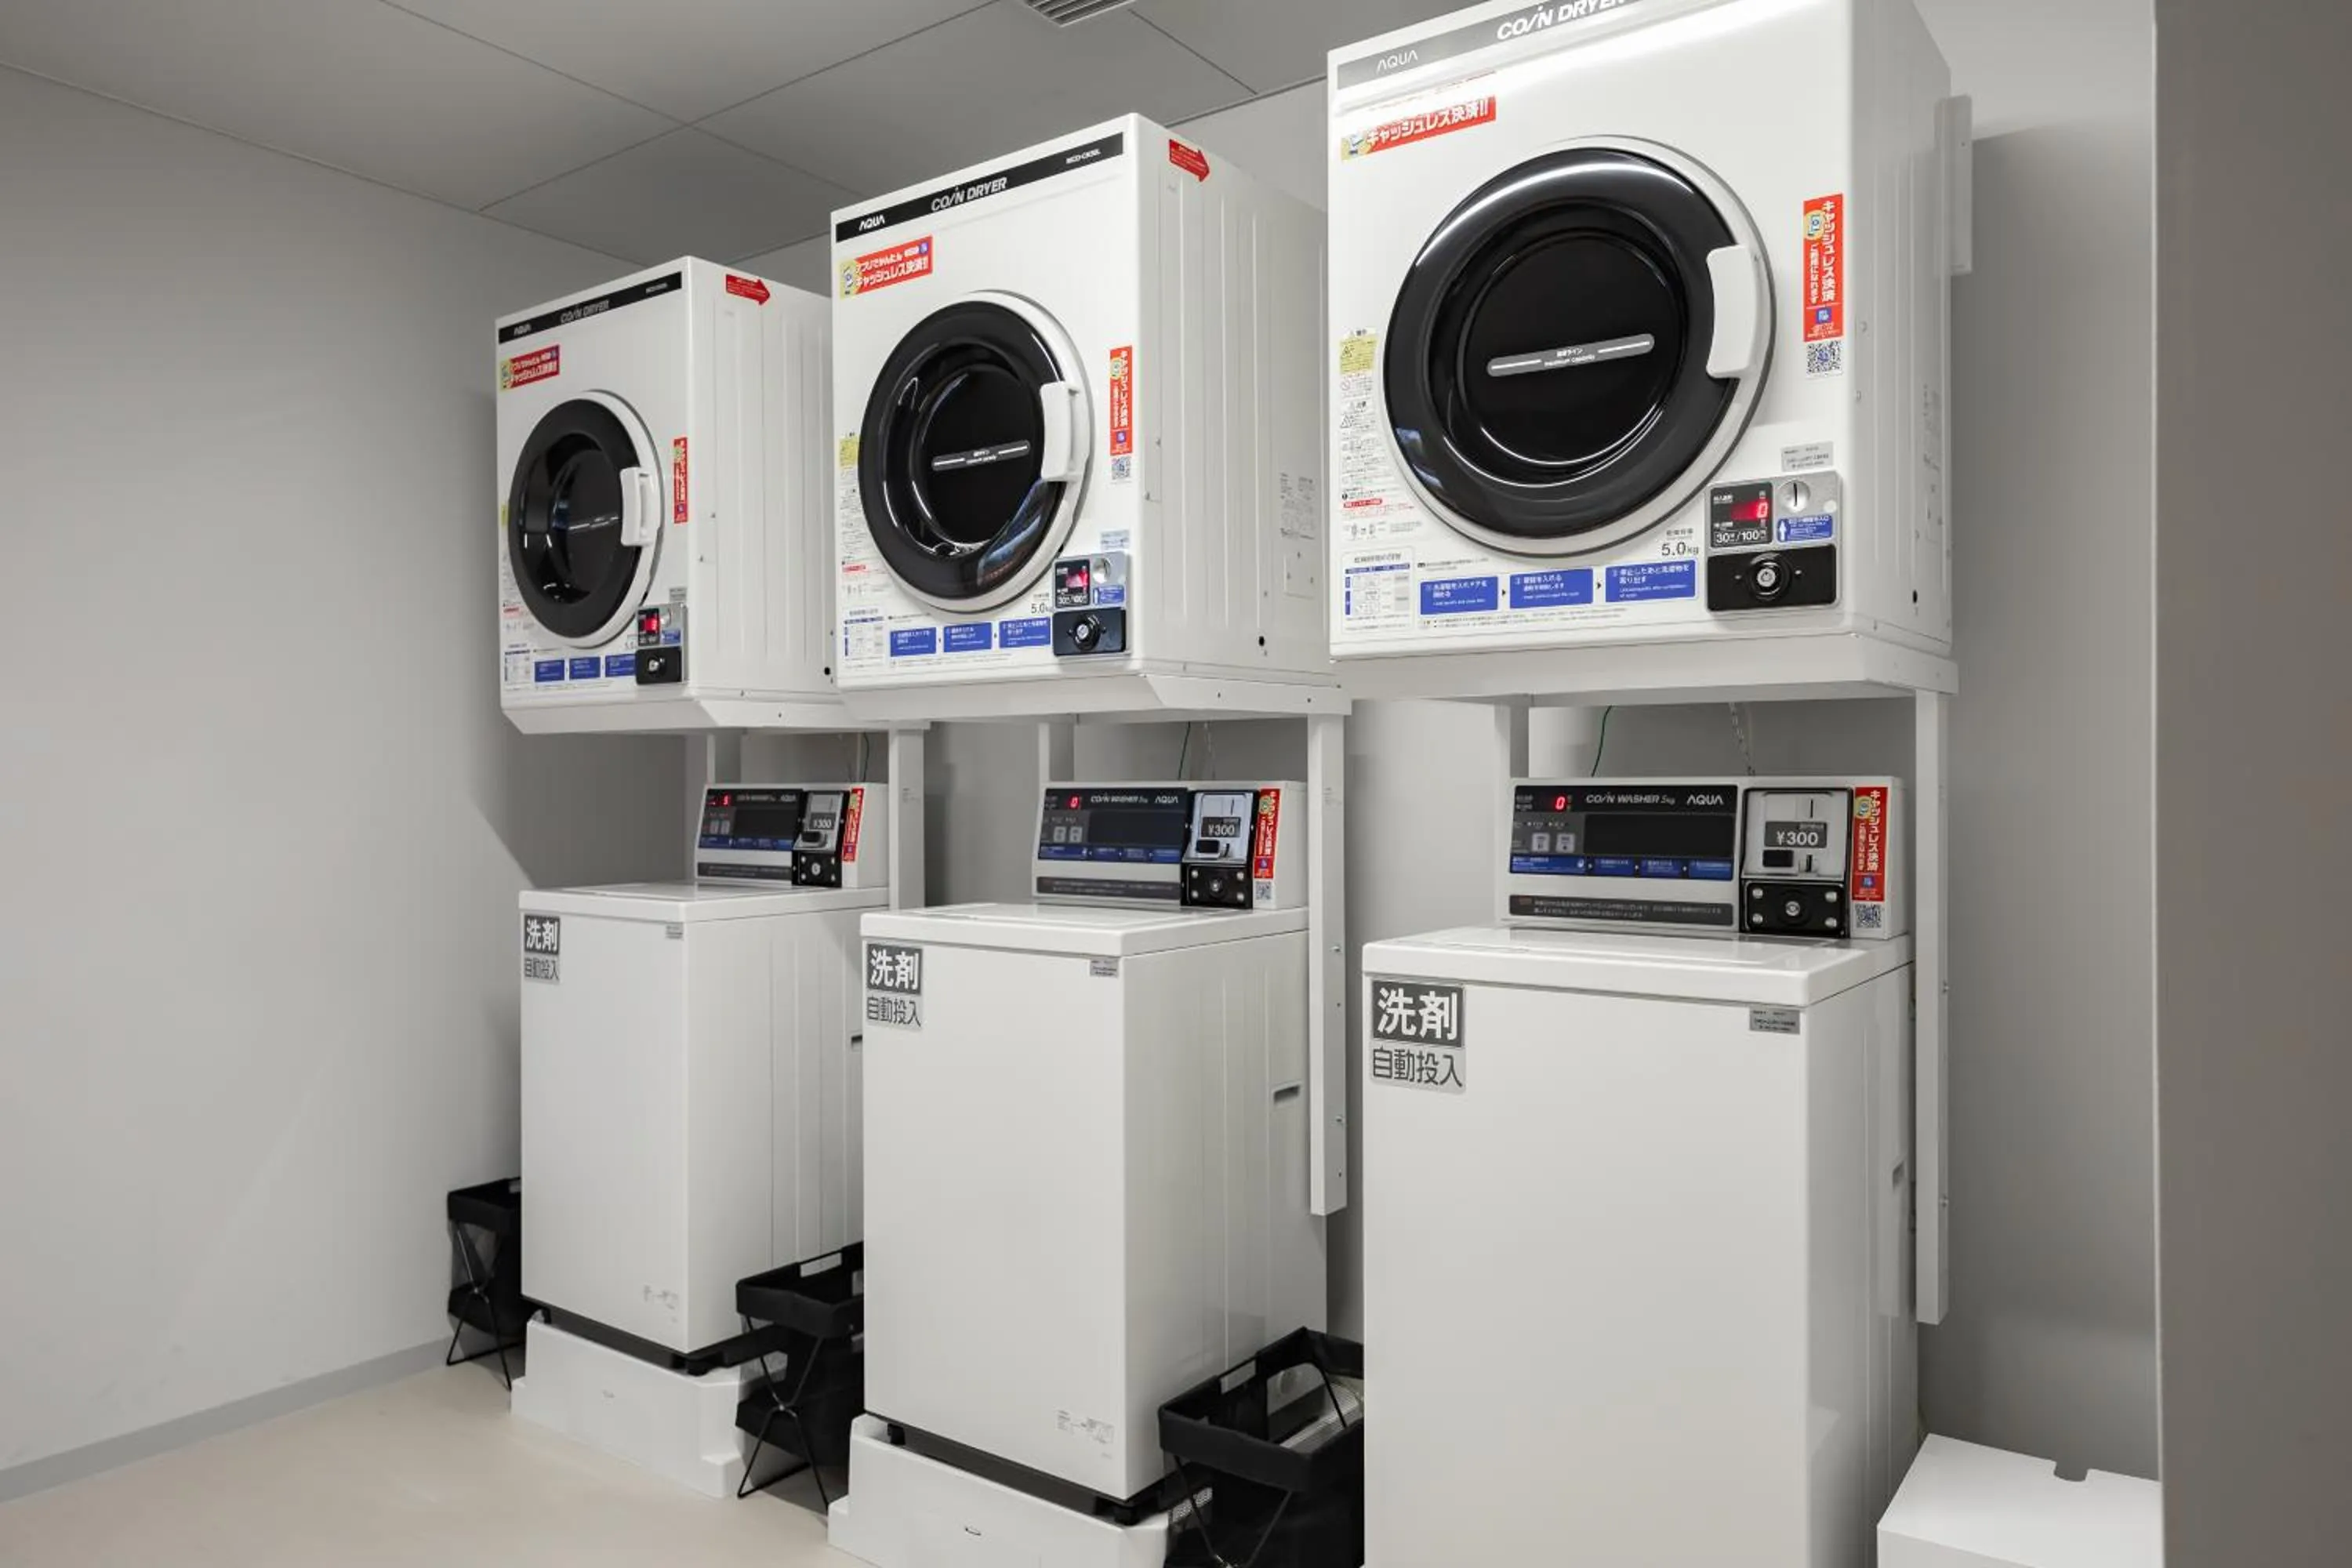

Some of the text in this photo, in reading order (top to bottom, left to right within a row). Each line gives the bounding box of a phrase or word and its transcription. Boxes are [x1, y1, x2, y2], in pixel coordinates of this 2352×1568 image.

[1558, 0, 1624, 22] DRYE
[1377, 49, 1418, 72] AQUA
[967, 177, 1007, 201] DRYER
[859, 215, 884, 231] AQUA
[1617, 794, 1660, 804] WASHER
[1687, 794, 1723, 805] AQUA
[1208, 824, 1235, 836] ¥300
[1777, 831, 1818, 845] ¥300
[526, 919, 557, 951] 洗剤
[870, 948, 919, 989] 洗剤
[867, 996, 921, 1027] 自動投入
[1377, 987, 1458, 1040] 洗剤
[1374, 1045, 1463, 1087] 自動投入
